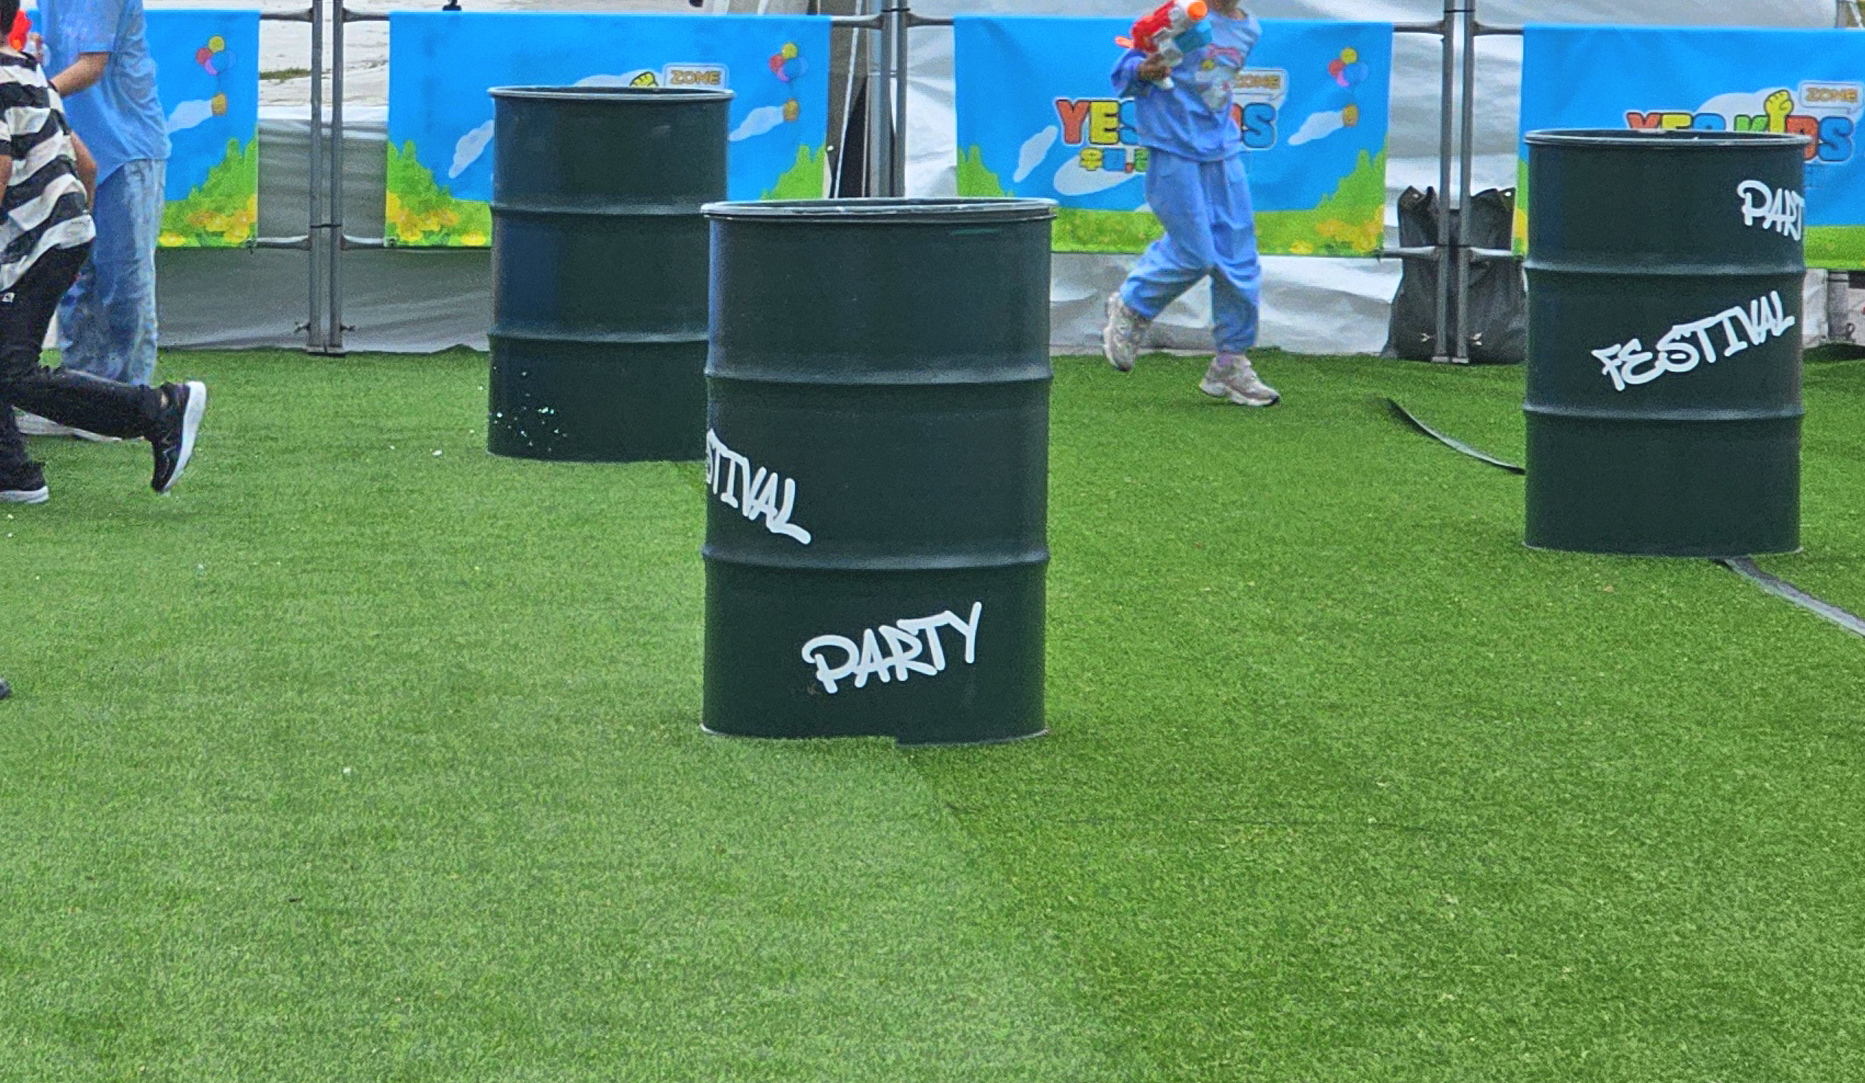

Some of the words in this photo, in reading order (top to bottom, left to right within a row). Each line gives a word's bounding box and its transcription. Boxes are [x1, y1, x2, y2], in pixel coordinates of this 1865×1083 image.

[670, 70, 722, 86] ZONE
[1805, 87, 1859, 103] ZONE
[1737, 180, 1803, 241] PART
[1591, 291, 1795, 391] FESTIVAL
[801, 601, 982, 693] PARTY
